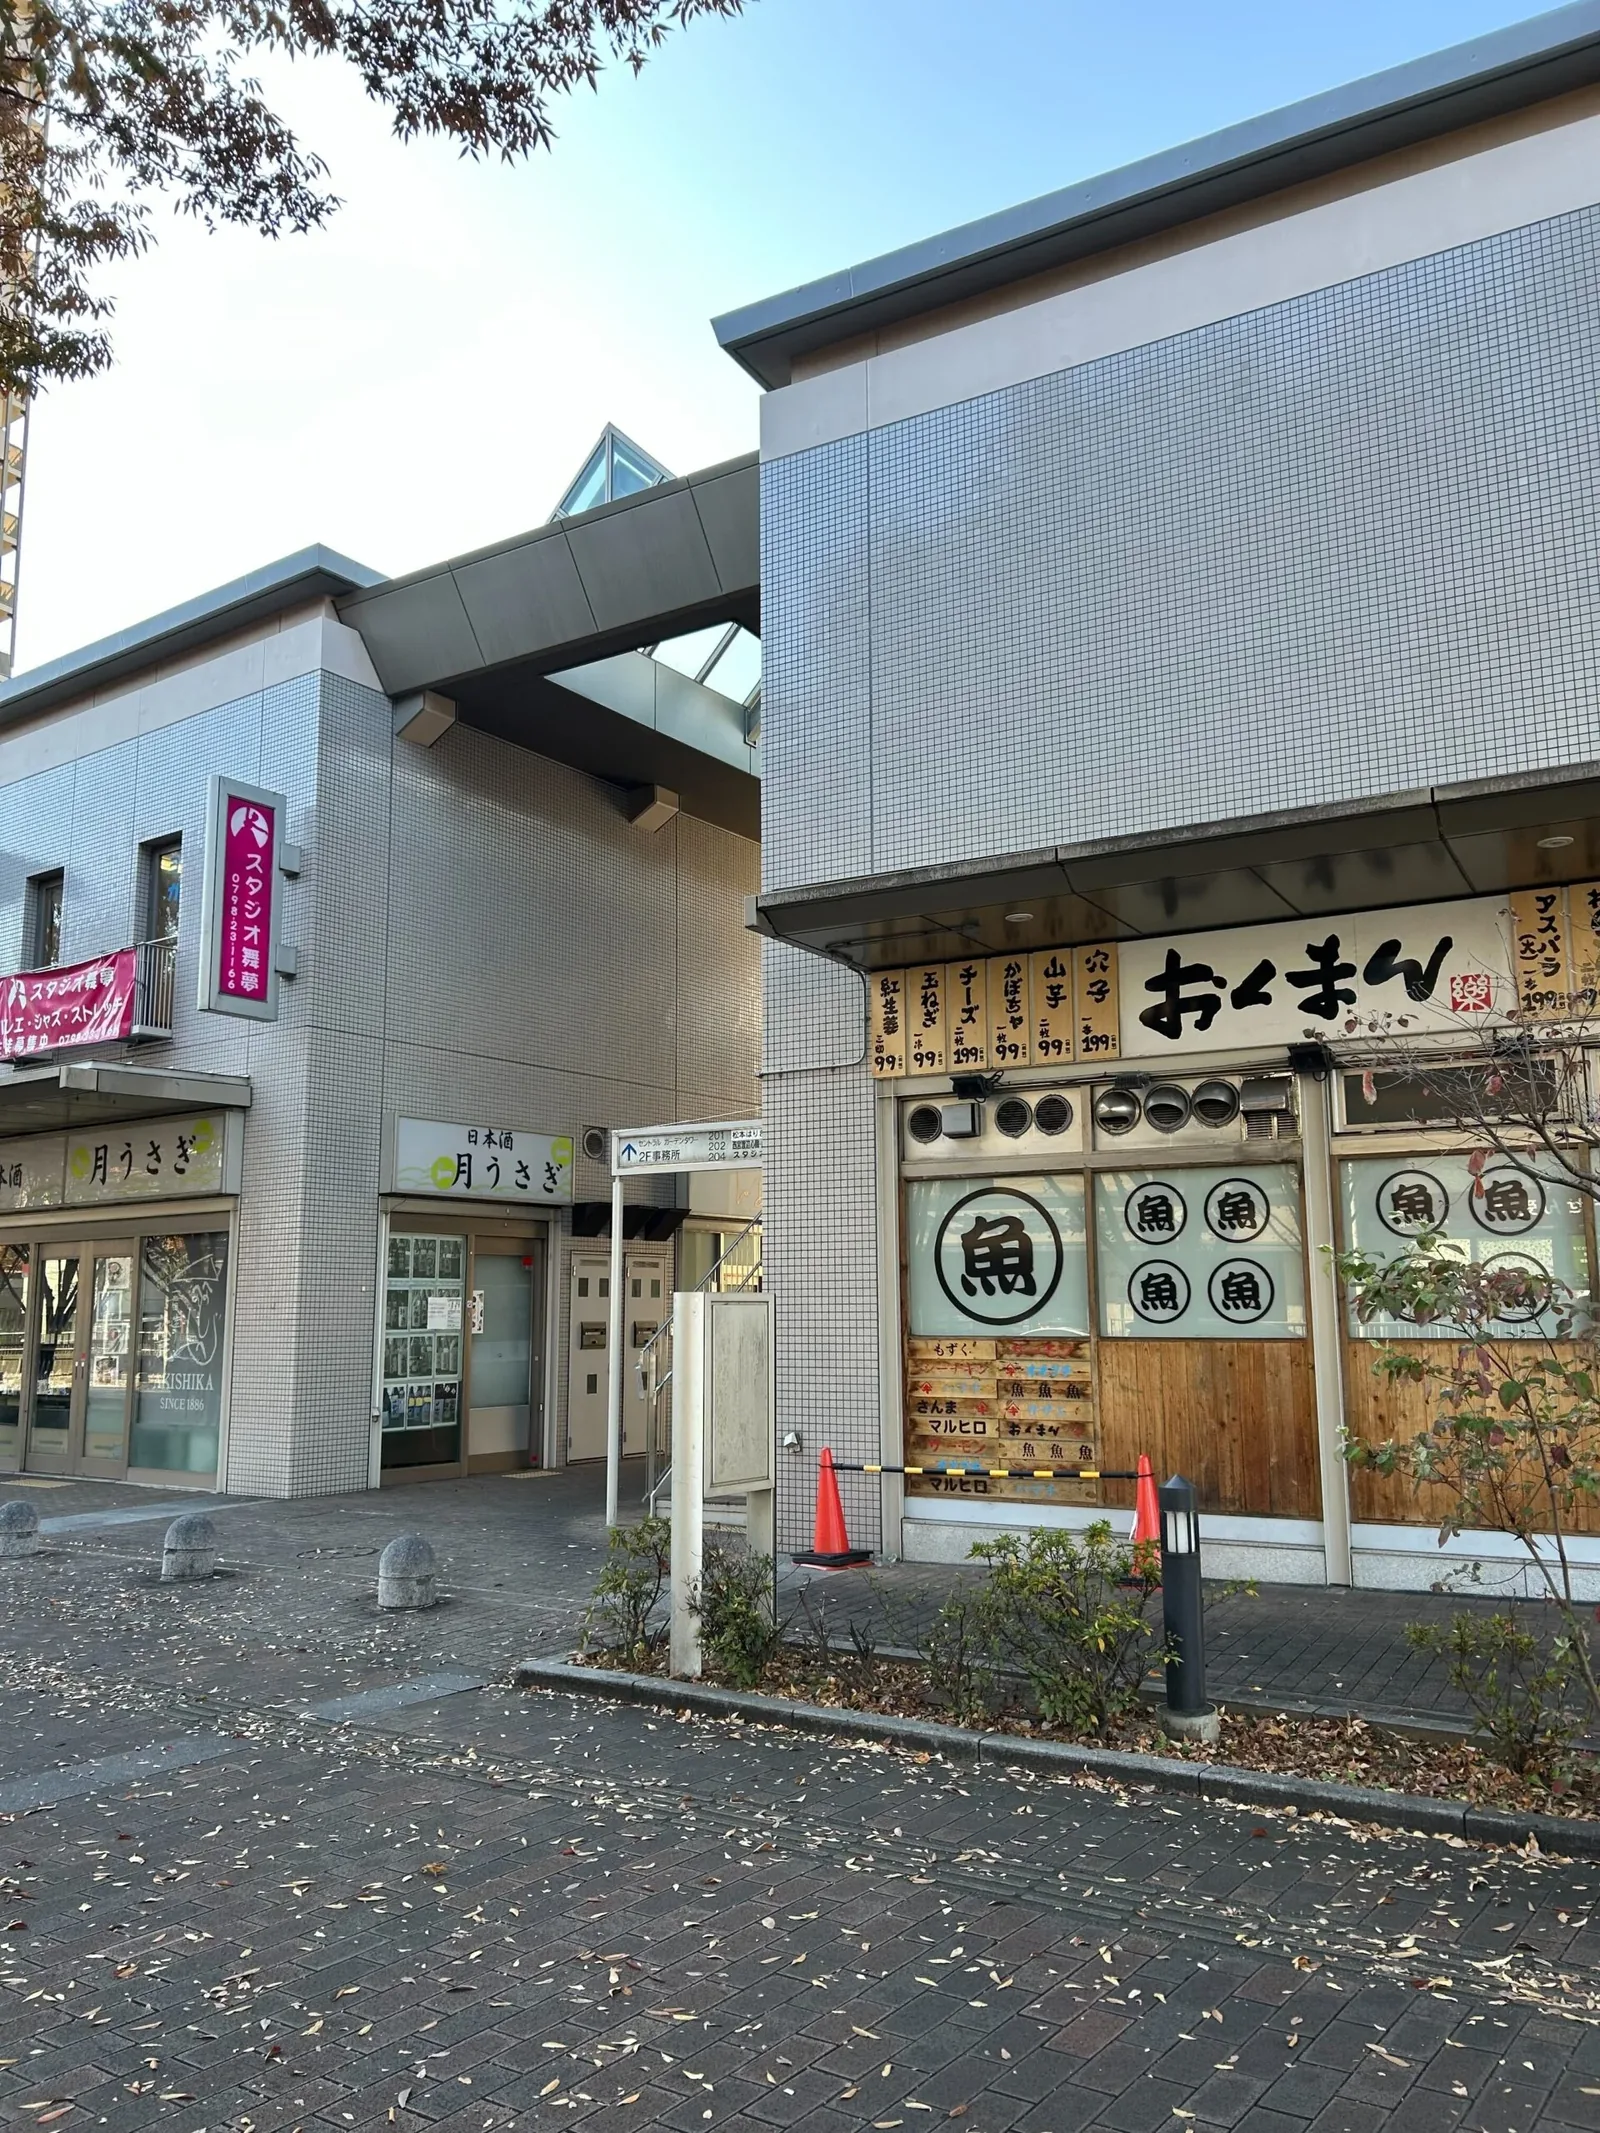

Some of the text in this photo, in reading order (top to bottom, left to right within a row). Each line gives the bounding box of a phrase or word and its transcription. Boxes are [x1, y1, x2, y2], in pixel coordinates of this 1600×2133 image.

[240, 853, 263, 992] スタジオ舞夢
[1535, 894, 1561, 977] アスパラ
[1043, 956, 1067, 1009] 山芋
[1085, 949, 1110, 1003] 穴子
[1139, 934, 1453, 1039] おくまん
[921, 972, 940, 1028] 玉ねぎ
[959, 965, 979, 1024] チーズ
[1004, 961, 1023, 1030] かぼちゃ
[1039, 1018, 1049, 1038] 二枚
[995, 1043, 1019, 1060] 99
[1038, 1039, 1063, 1056] 99
[1081, 1034, 1109, 1052] 199
[874, 1055, 896, 1071] 99
[913, 1050, 936, 1067] 99
[953, 1046, 979, 1064] 199
[467, 1128, 514, 1151] 日本酒
[708, 1131, 724, 1140] 201
[708, 1141, 726, 1151] 202
[89, 1135, 197, 1186] 月うさぎ
[638, 1149, 680, 1162] 2F事務所
[708, 1152, 726, 1161] 204
[451, 1153, 563, 1194] 月うさぎ
[1137, 1194, 1175, 1232] 魚
[1217, 1190, 1256, 1231] 魚
[961, 1215, 1037, 1297] 魚
[1140, 1272, 1178, 1311] 魚
[1221, 1271, 1261, 1311] 魚
[934, 1343, 968, 1356] もずく
[160, 1397, 186, 1410] SINCE
[917, 1399, 957, 1414] さんま
[929, 1419, 986, 1434] マルヒロ
[929, 1477, 987, 1494] マルヒロ
